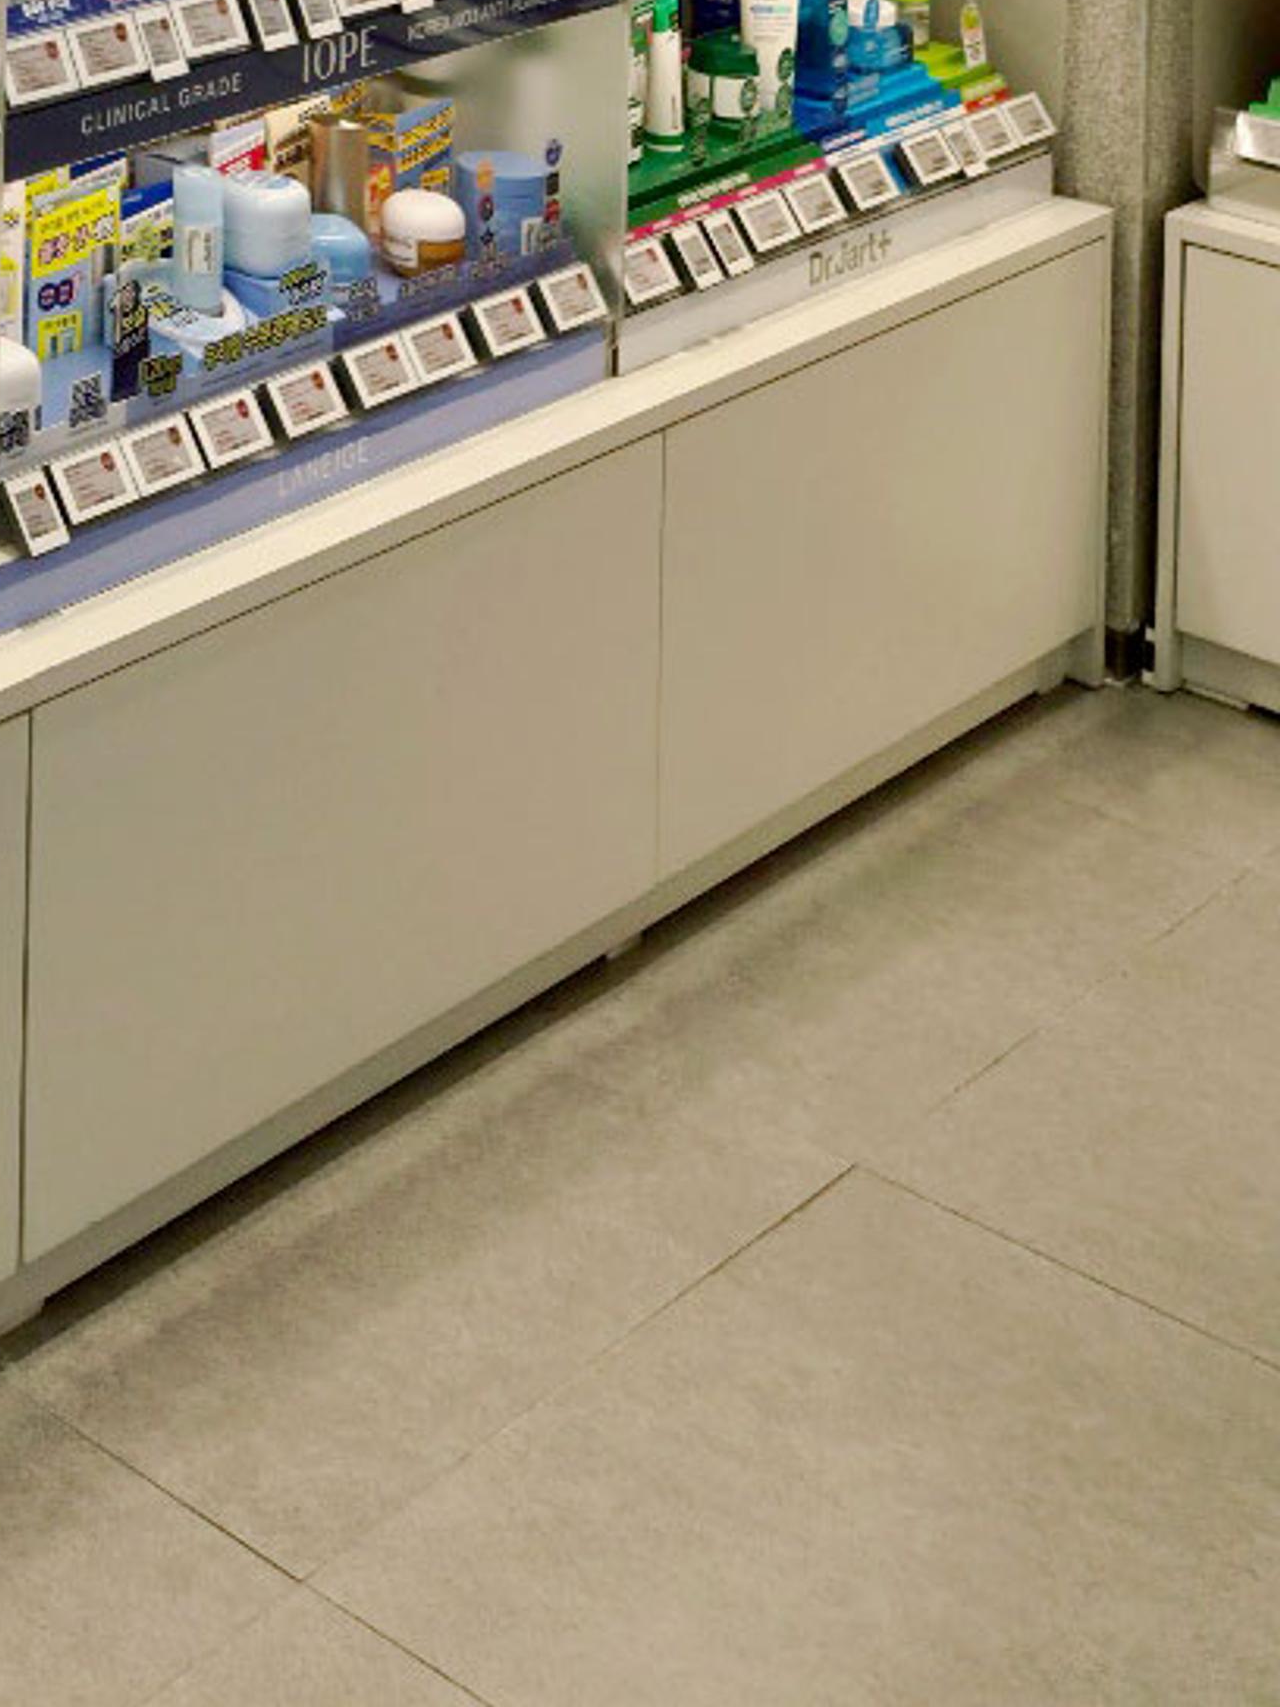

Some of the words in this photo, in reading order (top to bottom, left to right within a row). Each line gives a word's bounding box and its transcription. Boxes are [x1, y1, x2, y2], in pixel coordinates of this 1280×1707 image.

[302, 24, 378, 85] IOPE
[81, 92, 173, 135] CLINICAL
[177, 72, 244, 109] GRADE
